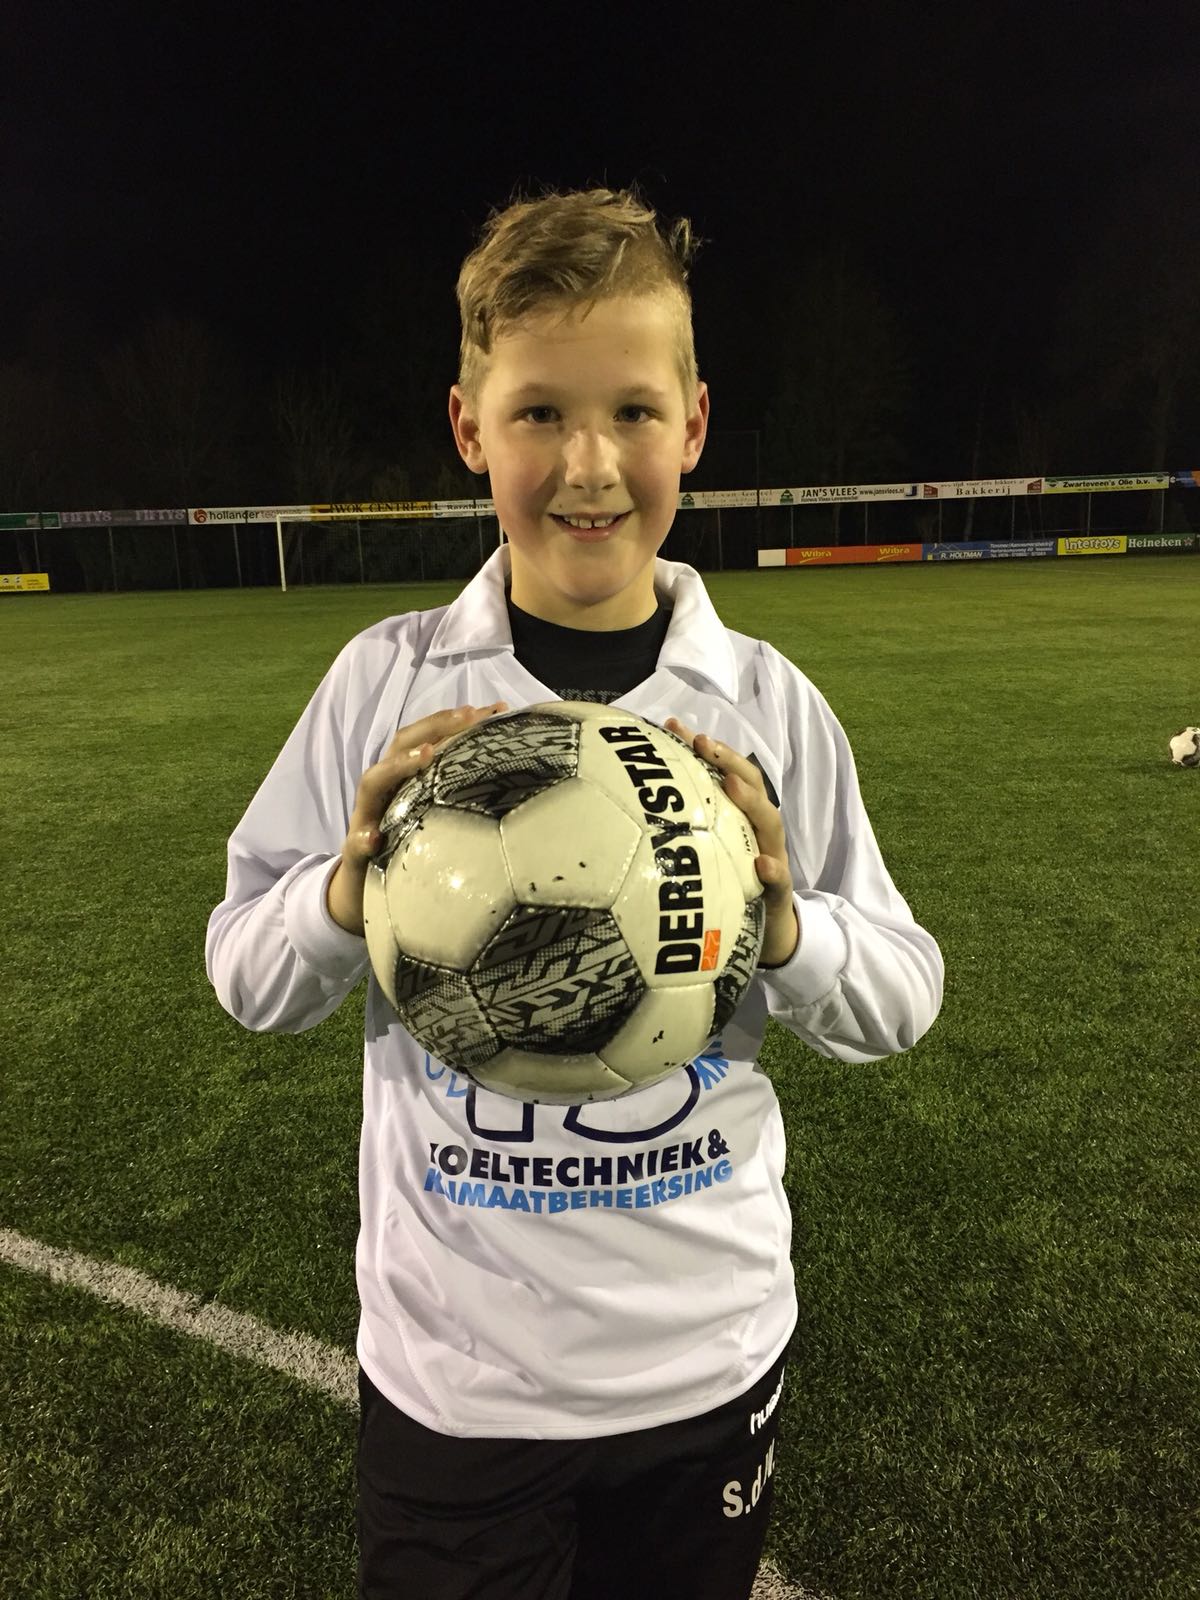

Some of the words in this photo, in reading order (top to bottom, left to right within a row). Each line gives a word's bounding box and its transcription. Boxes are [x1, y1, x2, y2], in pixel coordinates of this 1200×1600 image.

[801, 488, 828, 498] JAN'S
[830, 487, 858, 497] VLEES
[956, 486, 1011, 496] Bakkerij
[209, 509, 259, 521] hollander
[1065, 537, 1120, 551] Intertoys
[1128, 537, 1182, 548] Heineken
[801, 550, 832, 559] Wibra
[879, 546, 910, 555] Wibra
[949, 551, 983, 560] HOLTMAN
[599, 726, 704, 975] DERBYSTAR
[424, 1158, 733, 1214] KIMAATBEHEERSING
